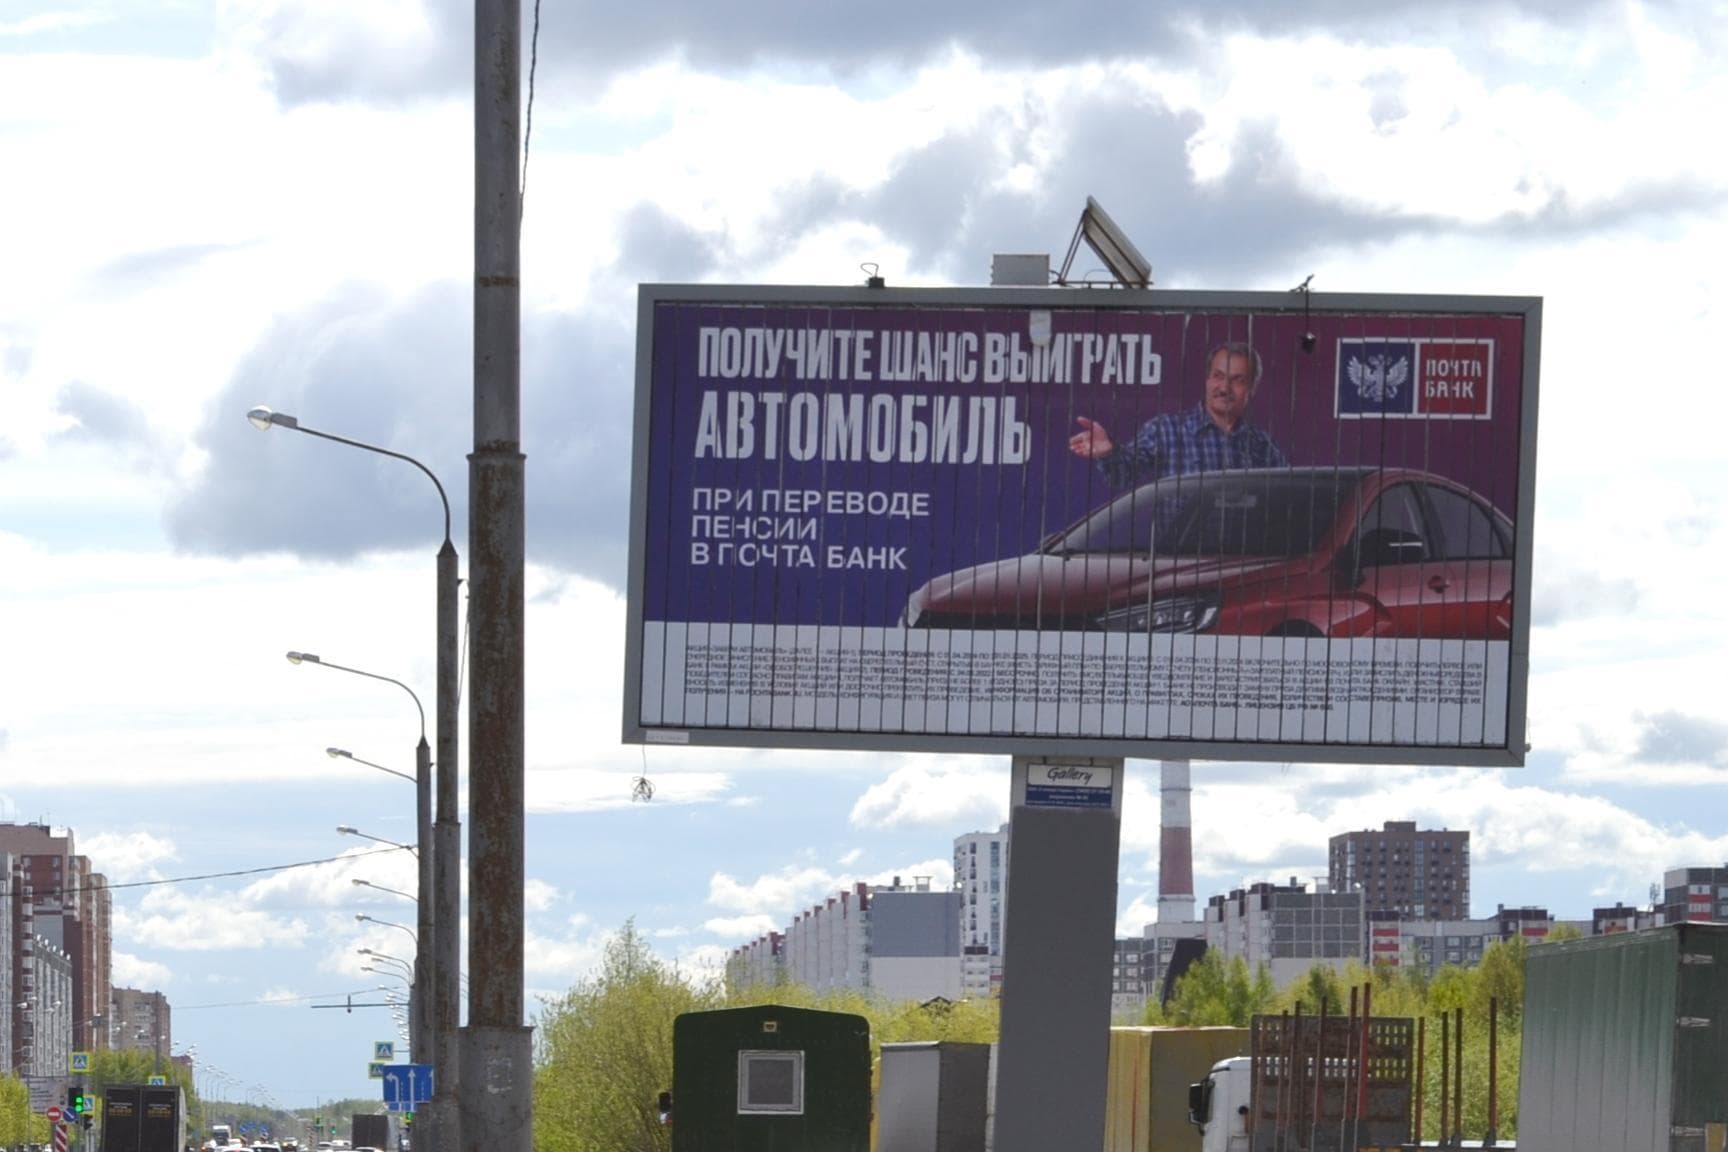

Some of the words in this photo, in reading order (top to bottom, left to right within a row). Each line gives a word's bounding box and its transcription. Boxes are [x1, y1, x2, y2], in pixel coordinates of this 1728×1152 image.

[698, 327, 874, 380] ПОЛУЧИТЕ
[879, 330, 979, 383] ШАНС
[984, 332, 1162, 385] ВЫИГРАТЬ
[1426, 359, 1482, 377] ПОЧТА
[1425, 381, 1474, 398] БАНК
[694, 390, 1032, 465] АВТОМОБИЛЬ
[692, 488, 753, 511] ПРИ
[762, 489, 930, 520] ПЕРЕВОДЕ
[691, 515, 817, 541] ПЕНСИИ
[691, 542, 709, 565] В
[718, 543, 815, 568] ПОЧТА
[827, 546, 907, 570] БАНК
[1047, 767, 1093, 784] Gallery
